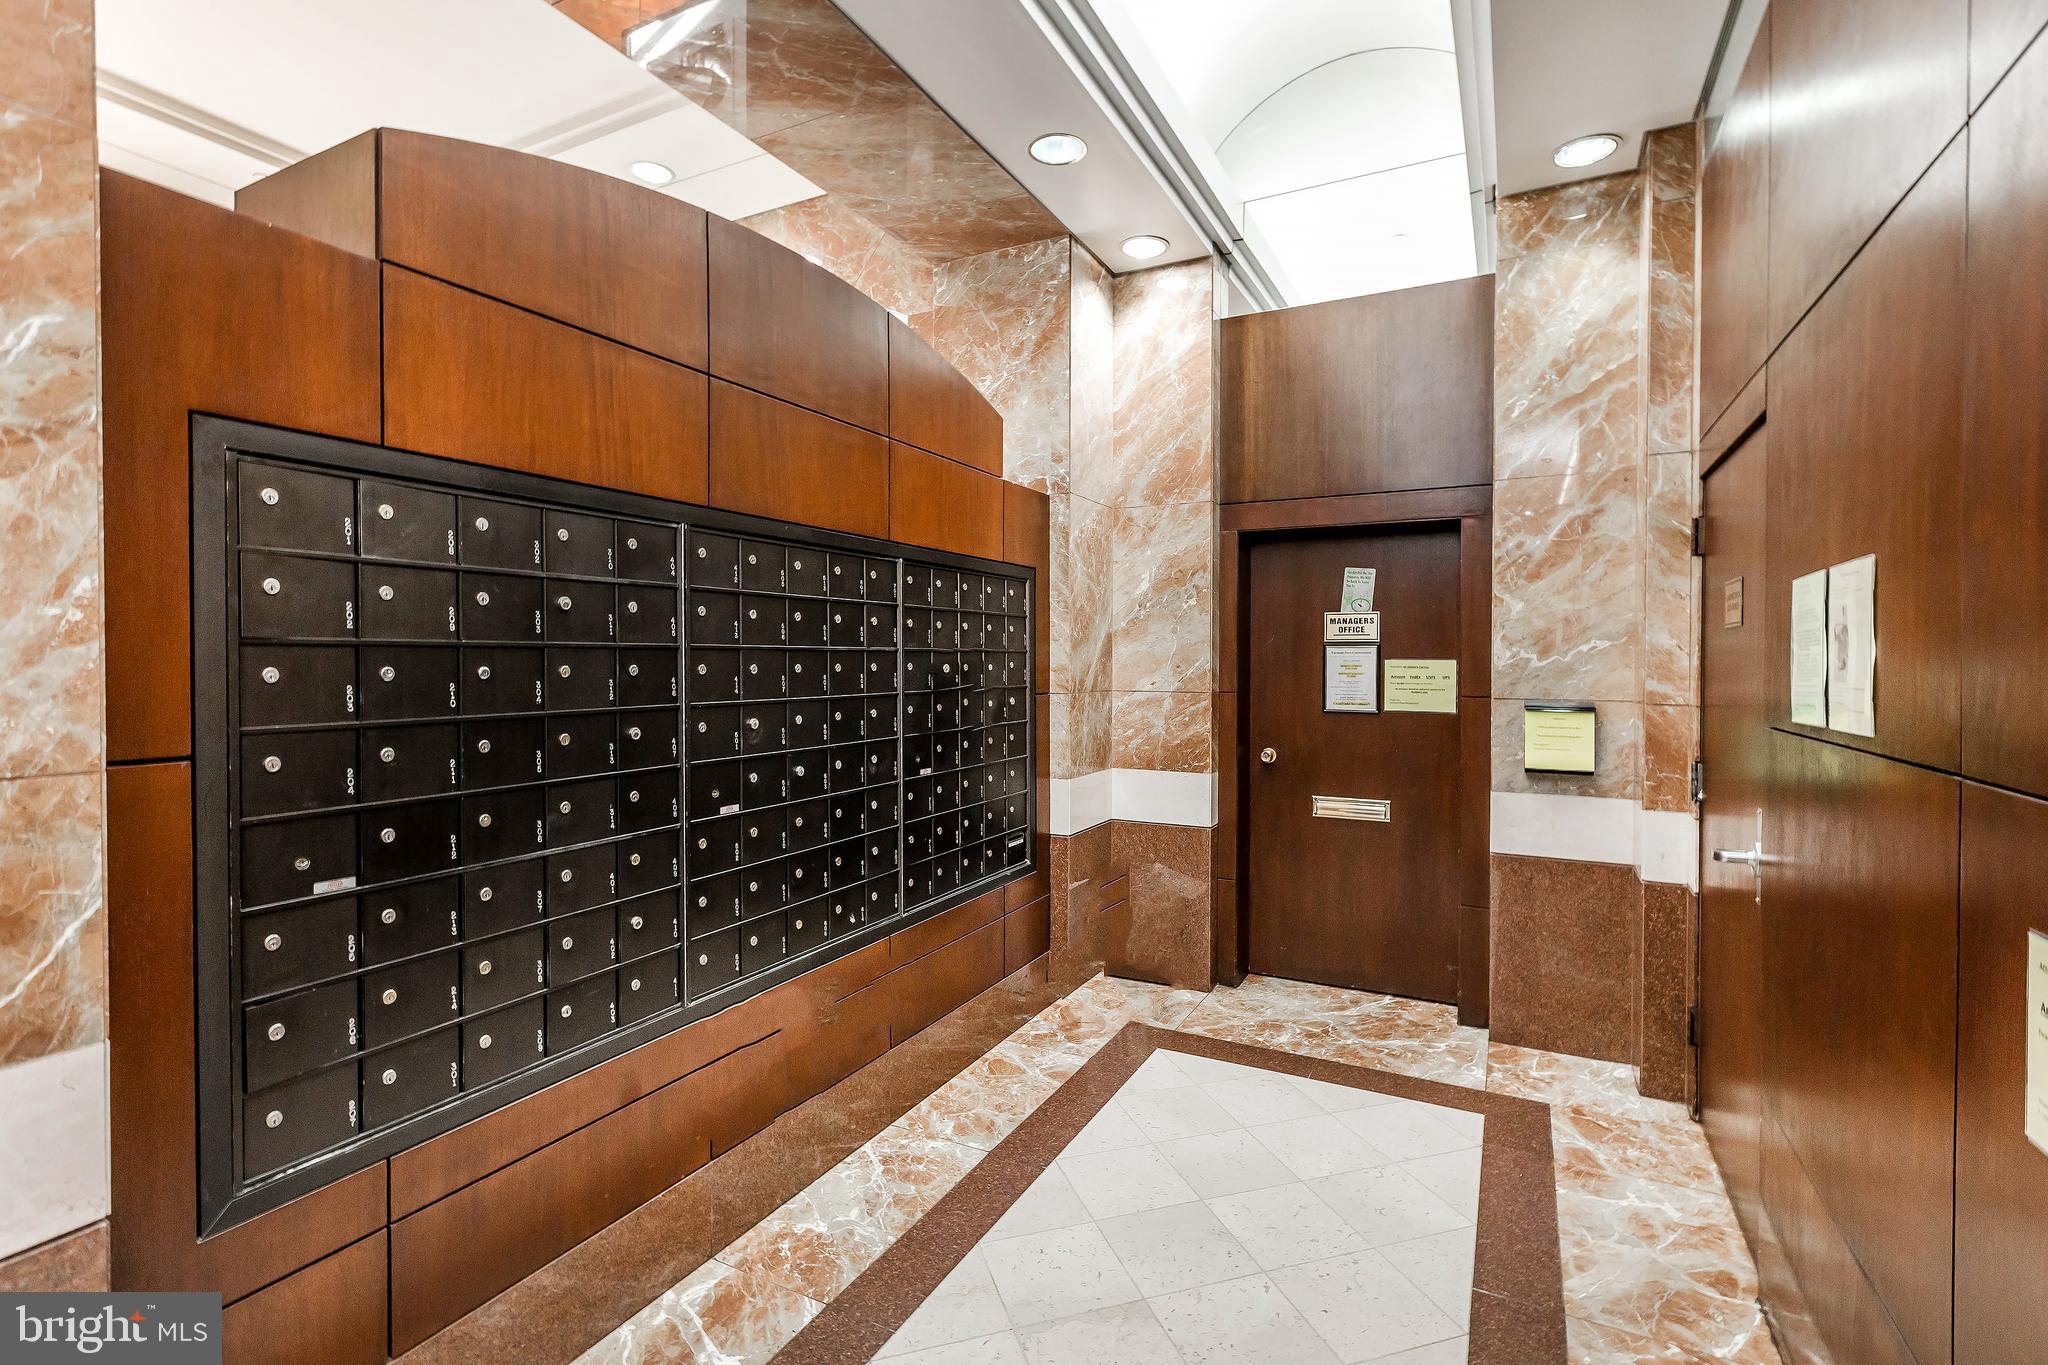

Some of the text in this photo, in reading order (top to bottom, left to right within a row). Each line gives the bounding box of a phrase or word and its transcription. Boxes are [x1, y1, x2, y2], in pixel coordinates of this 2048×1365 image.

[344, 517, 352, 546] 201
[447, 529, 455, 556] 208
[345, 601, 354, 629] 202
[448, 606, 456, 632] 209
[1329, 617, 1375, 625] MANAGERS
[346, 684, 354, 713] 203
[449, 682, 457, 708] 210
[346, 767, 355, 796] 204
[450, 910, 458, 936] 213
[347, 934, 356, 962] 205
[450, 985, 458, 1011] 214
[348, 1017, 357, 1045] 206
[536, 1029, 544, 1053] 309
[450, 1061, 458, 1087] 301
[348, 1099, 357, 1128] 207
